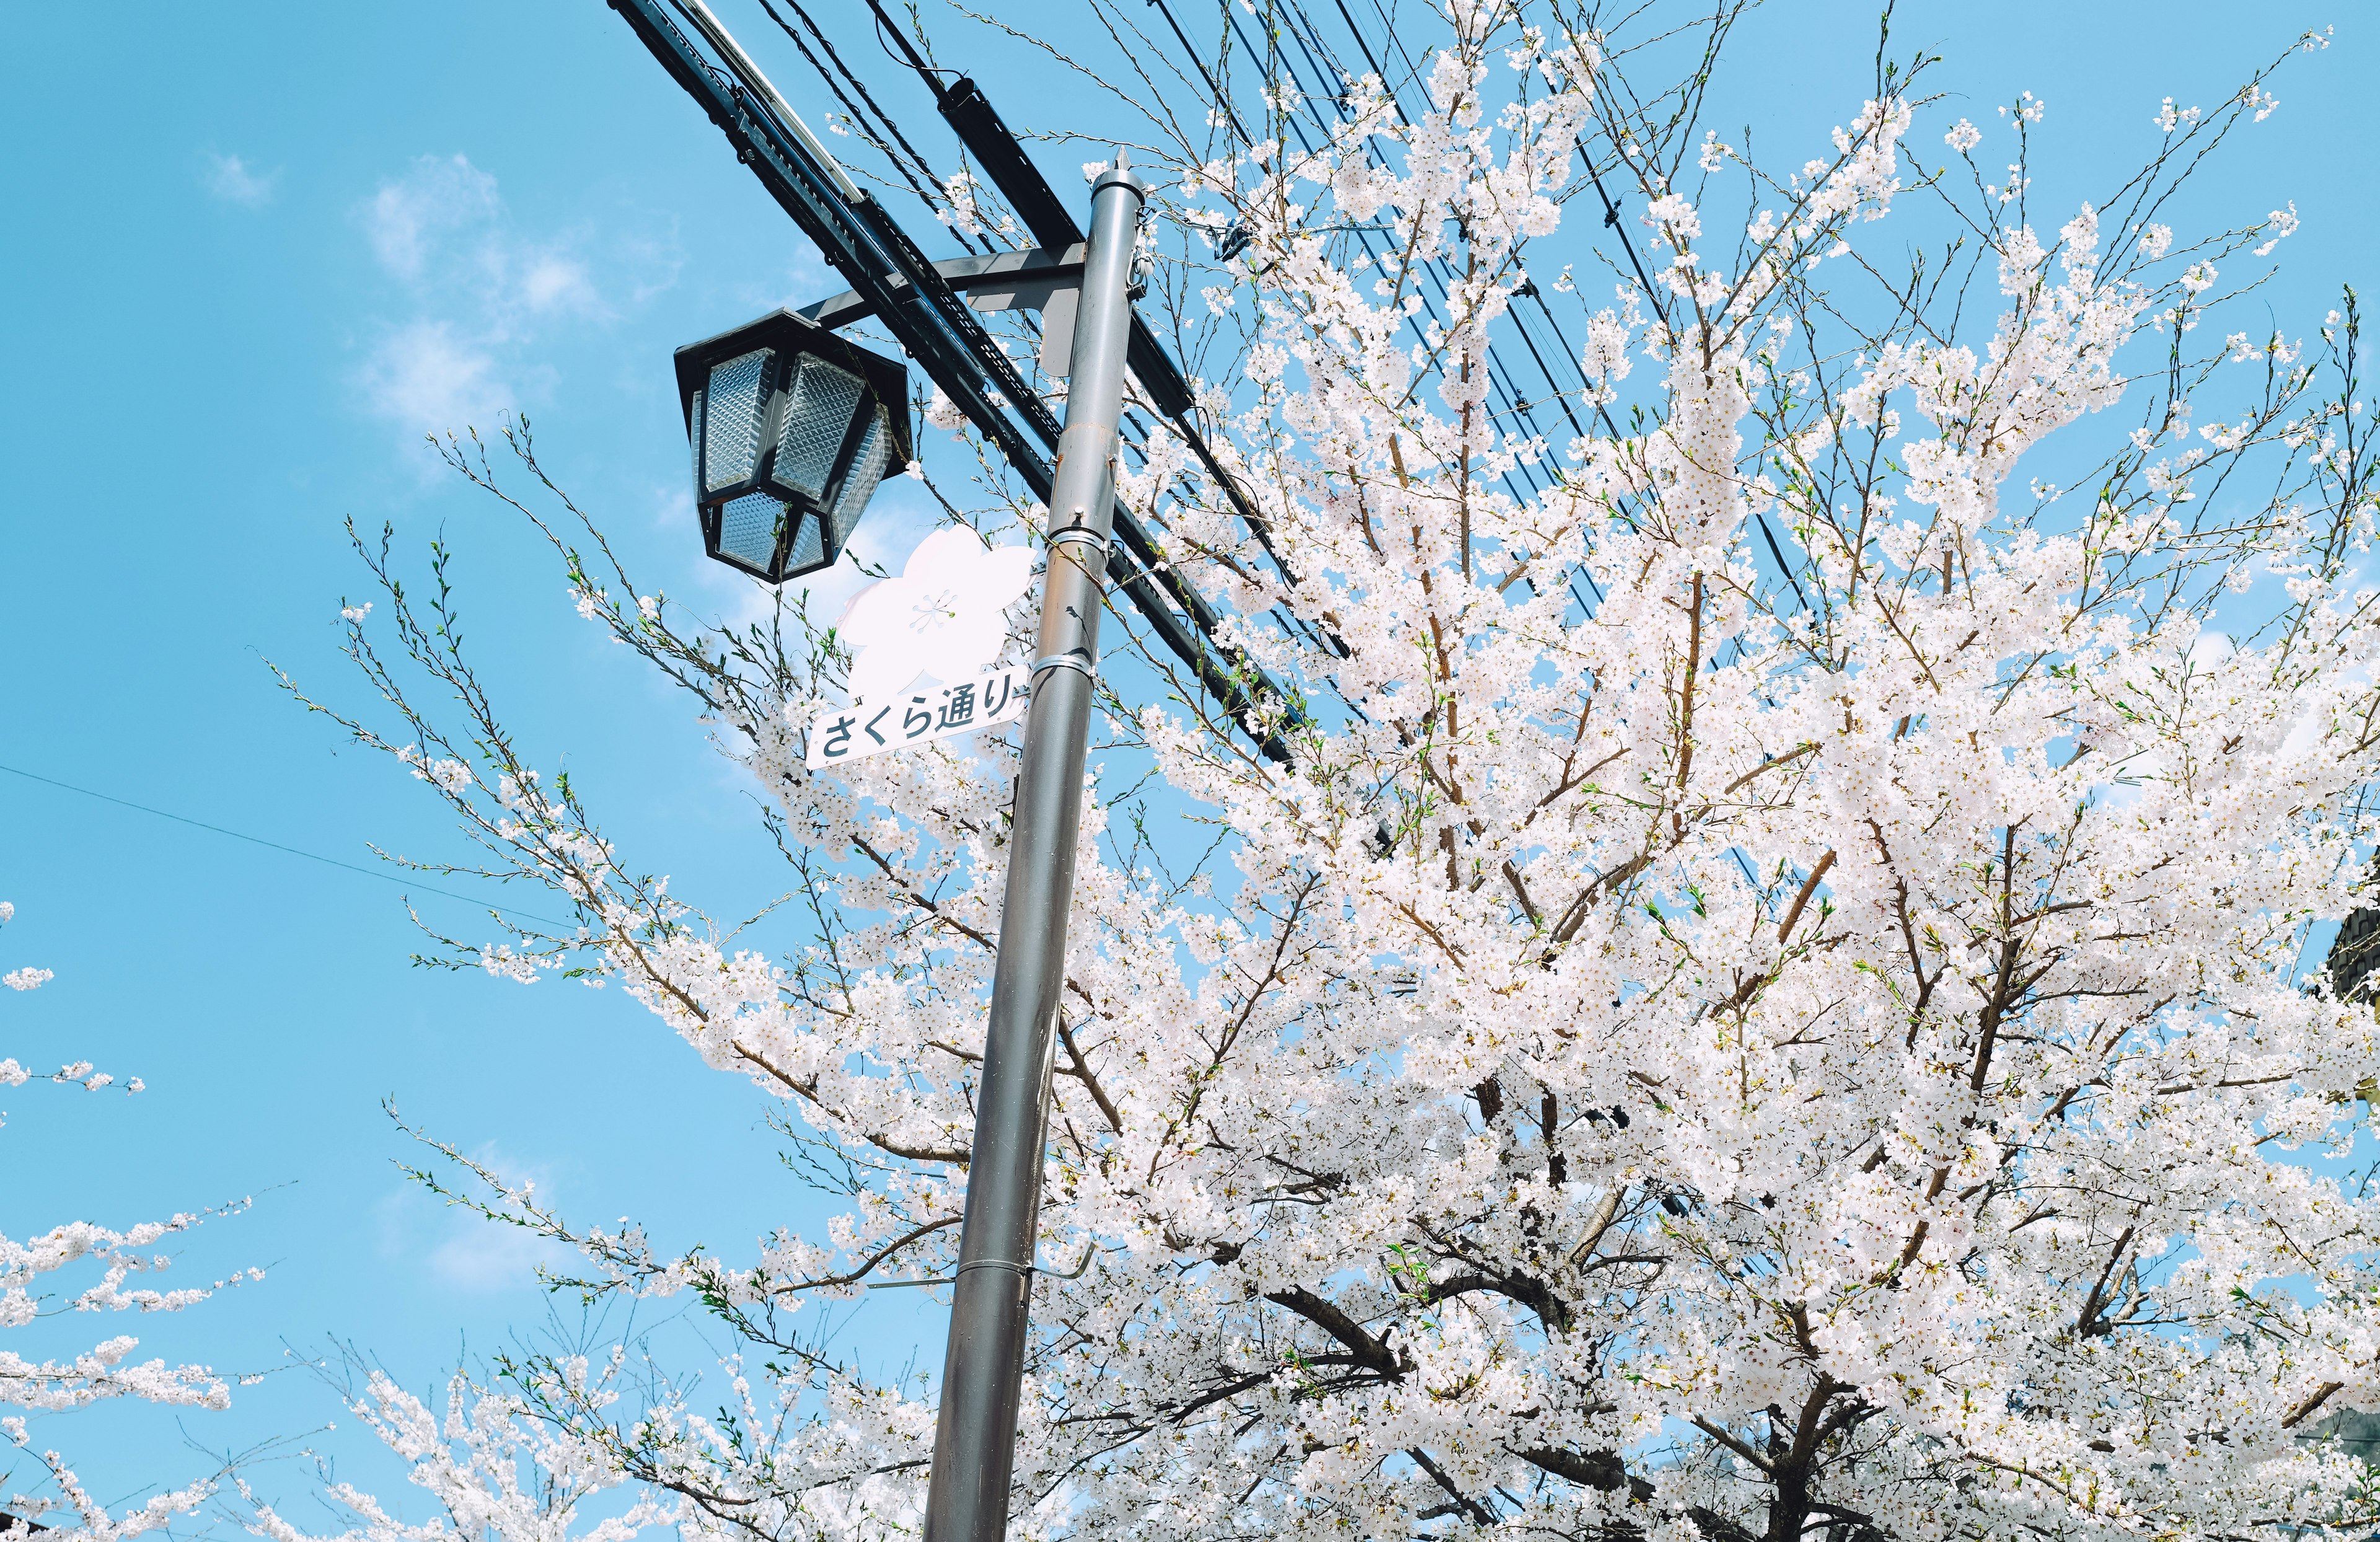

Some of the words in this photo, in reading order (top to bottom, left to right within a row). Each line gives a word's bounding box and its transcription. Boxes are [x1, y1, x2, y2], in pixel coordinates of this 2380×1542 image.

[823, 674, 1011, 757] さくら通り
